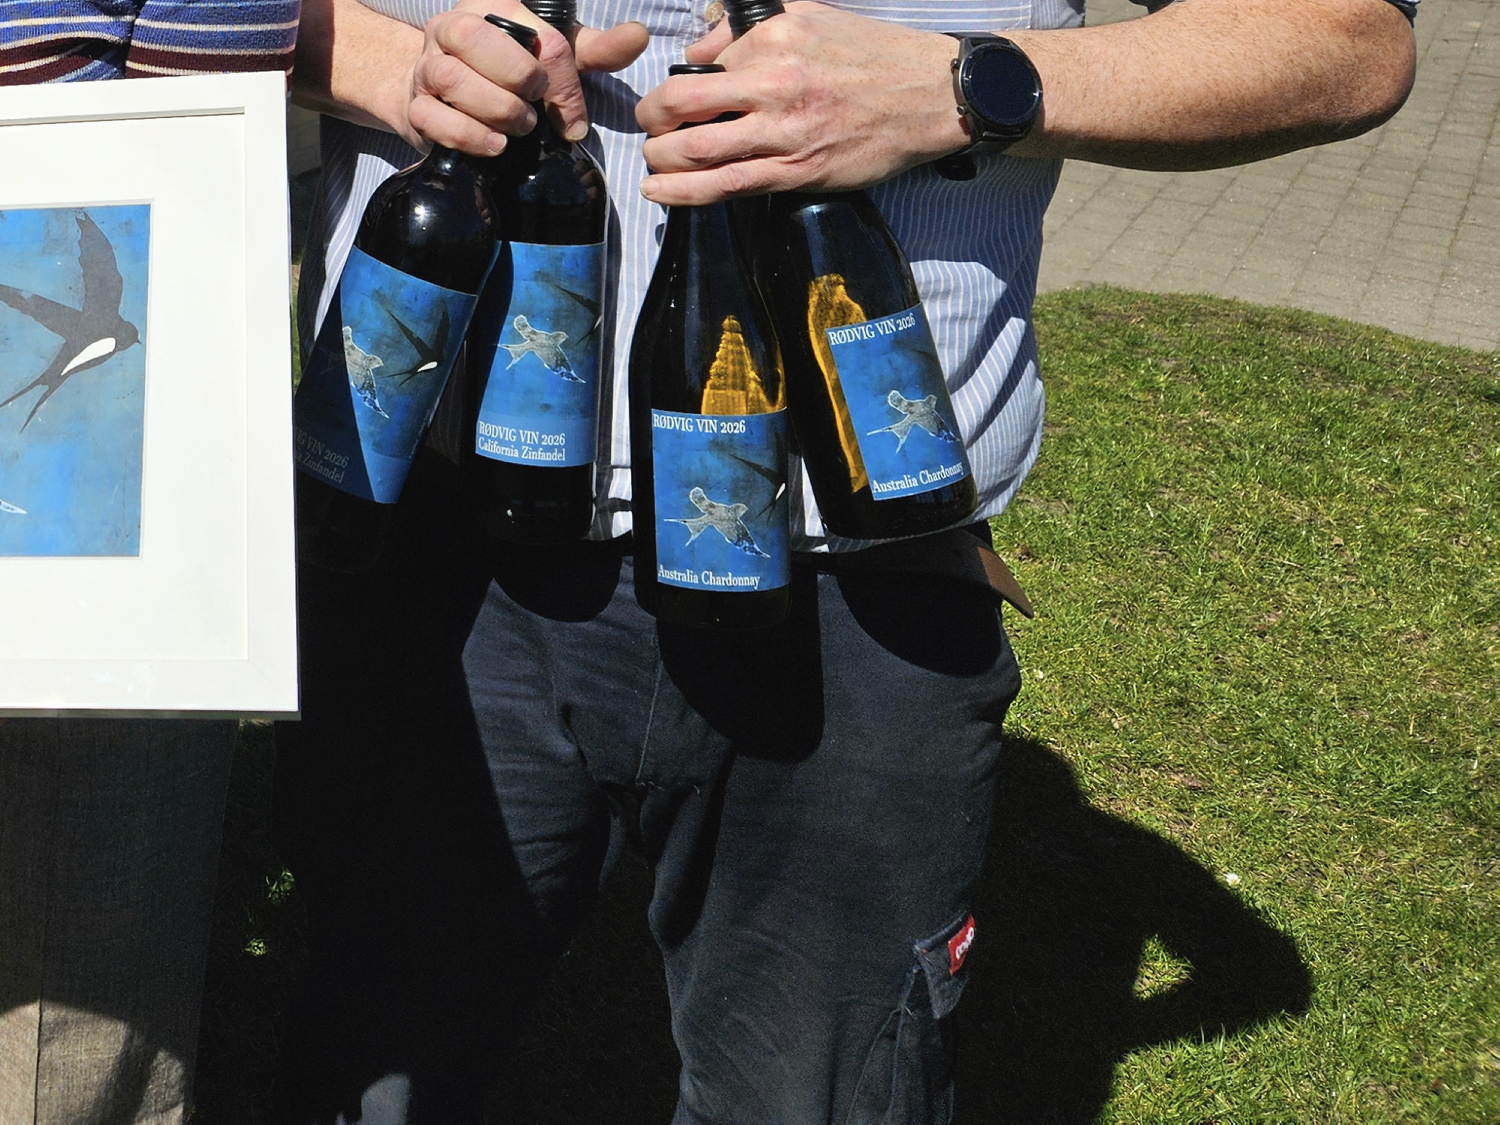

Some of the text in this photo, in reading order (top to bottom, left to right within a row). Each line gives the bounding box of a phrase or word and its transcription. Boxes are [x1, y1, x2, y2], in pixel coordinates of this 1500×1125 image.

[829, 313, 916, 346] RØDVIG VIN 2026
[478, 420, 565, 446] RØDVIG VIN 2026
[652, 414, 746, 434] RØDVIG VIN 2026
[478, 436, 565, 461] California Zinfandel
[302, 452, 345, 483] Zinfandel
[872, 462, 964, 493] Australia Chardonnay
[658, 565, 760, 589] Australia Chardonnay
